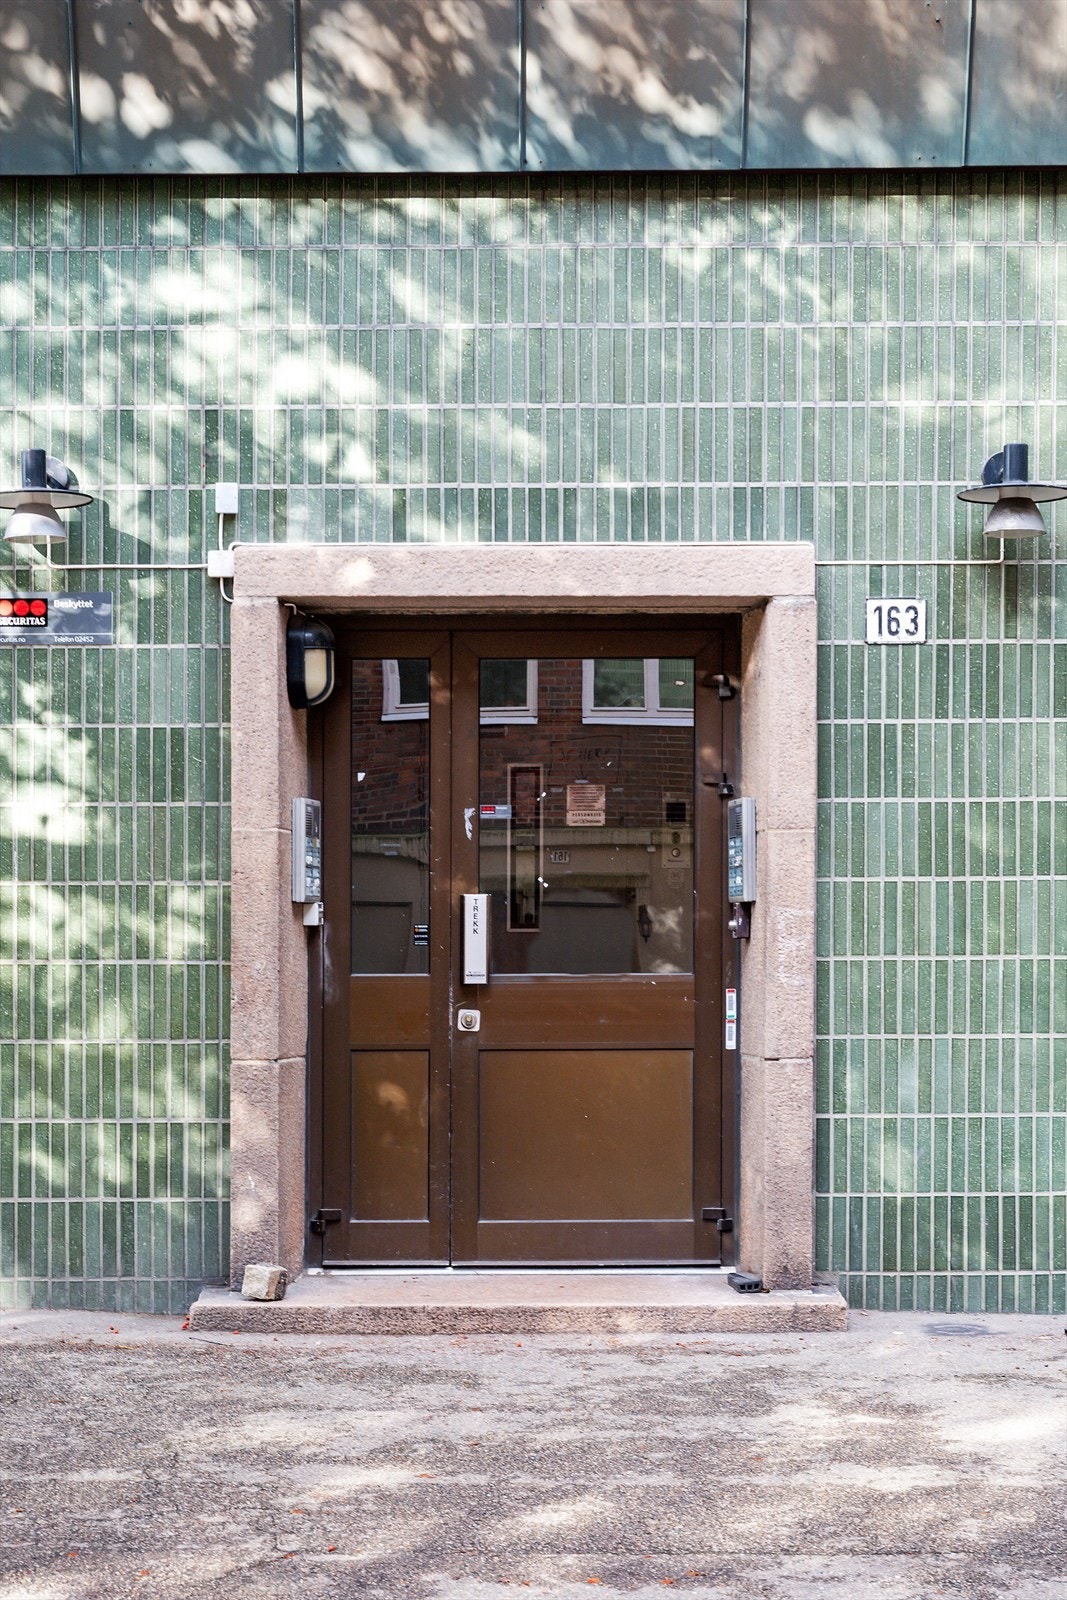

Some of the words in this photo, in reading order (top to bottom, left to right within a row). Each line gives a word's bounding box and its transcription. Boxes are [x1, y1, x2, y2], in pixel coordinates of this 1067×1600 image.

[54, 600, 93, 609] Beskyttet
[873, 605, 919, 637] 163
[54, 635, 74, 643] Telefon
[75, 635, 94, 643] 02452
